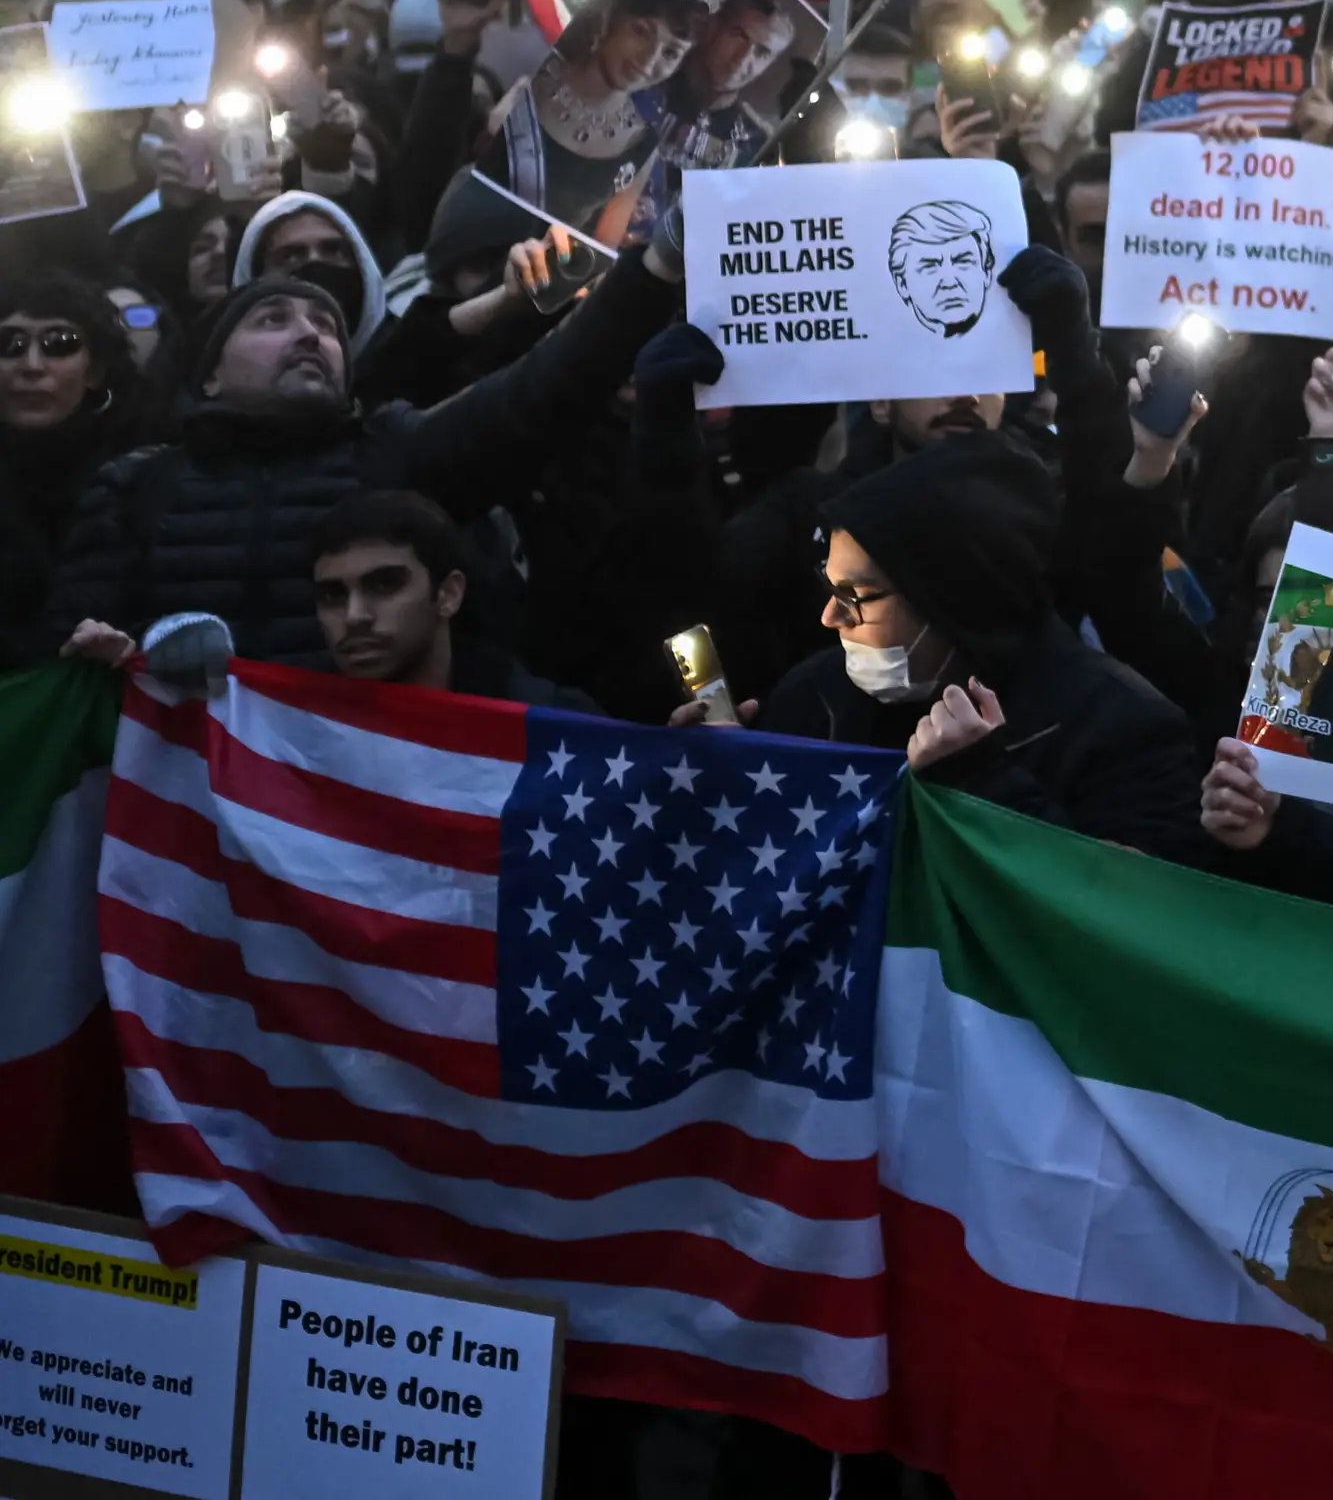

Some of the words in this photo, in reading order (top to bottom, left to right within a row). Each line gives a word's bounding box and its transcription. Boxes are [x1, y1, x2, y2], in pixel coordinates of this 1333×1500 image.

[1166, 17, 1284, 48] LOCKED
[1152, 54, 1304, 100] LEGEND
[1201, 151, 1295, 180] 12,000
[726, 220, 784, 246] END
[790, 216, 844, 242] THE
[1150, 194, 1223, 220] dead
[1235, 197, 1261, 221] in
[1272, 198, 1331, 230] Iran.
[719, 246, 855, 277] MULLAHS
[1123, 235, 1208, 263] History
[1216, 238, 1236, 259] is
[730, 289, 848, 317] DESERVE
[1159, 275, 1220, 307] Act
[1232, 283, 1317, 314] now.
[718, 322, 769, 346] THE
[774, 317, 868, 344] NOBEL.
[1247, 695, 1279, 724] King
[1282, 707, 1331, 736] Reza
[0, 1247, 103, 1285] resident
[109, 1263, 198, 1306] Trump!
[279, 1298, 396, 1349] People
[406, 1326, 444, 1357] of
[451, 1331, 519, 1372] Iran
[30, 1348, 147, 1386] appreciate
[152, 1372, 193, 1397] and
[307, 1357, 388, 1400] have
[397, 1376, 483, 1419] done
[38, 1383, 75, 1408] will
[81, 1393, 142, 1421] never
[51, 1423, 99, 1448] your
[105, 1435, 194, 1469] support.
[305, 1411, 386, 1453] their
[394, 1434, 477, 1472] part!
